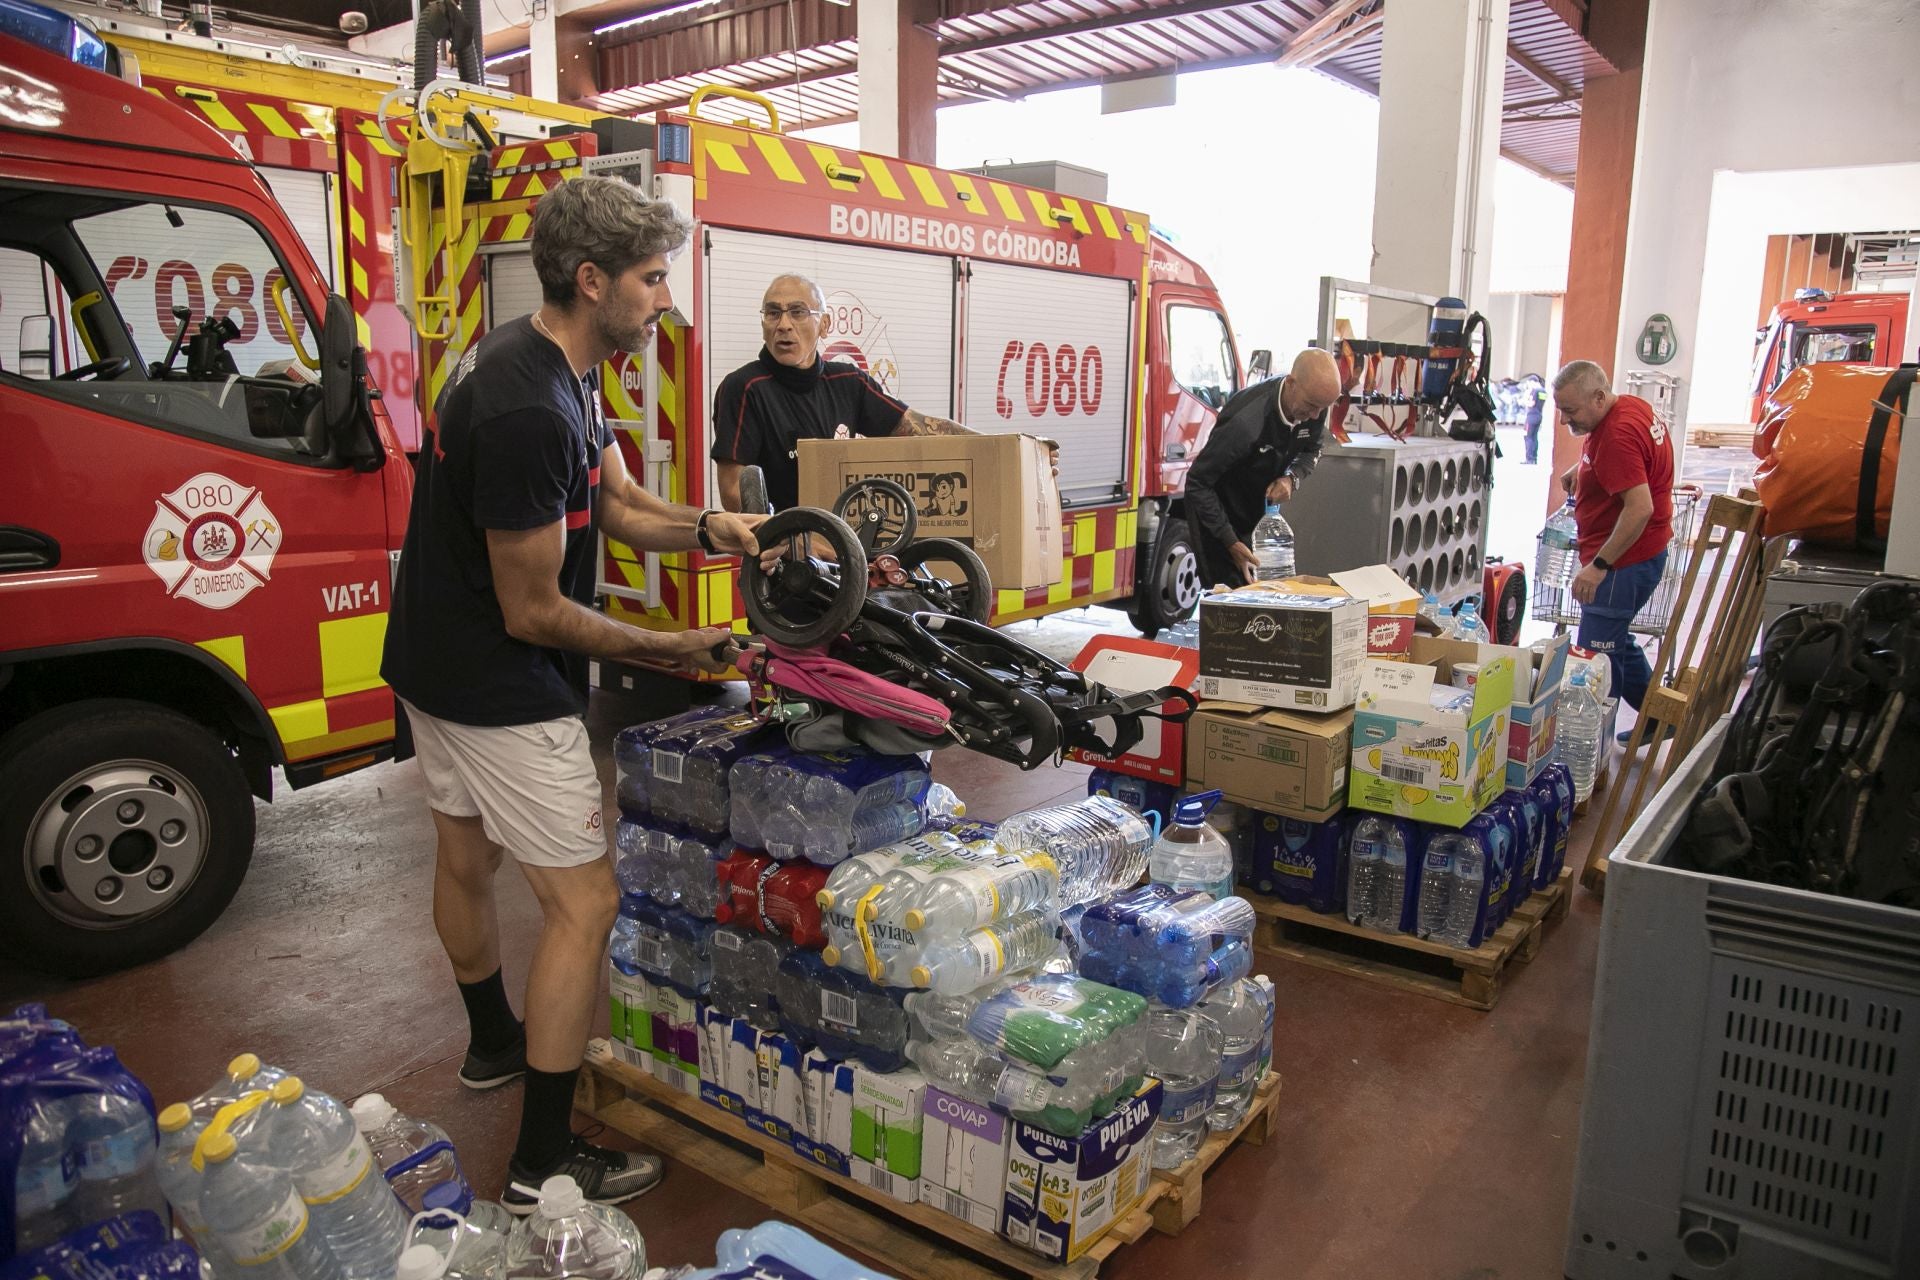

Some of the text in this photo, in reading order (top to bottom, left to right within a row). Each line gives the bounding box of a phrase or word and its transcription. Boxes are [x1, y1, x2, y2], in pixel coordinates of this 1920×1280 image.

[830, 204, 1081, 268] BOMBEROS CÓRDOBA
[1025, 341, 1103, 418] 080
[185, 484, 233, 509] 080
[194, 572, 246, 595] BOMBEROS
[322, 580, 380, 612] VAT-1
[1590, 641, 1615, 649] SEUR
[860, 1085, 904, 1109] SEMIDESNATADA
[937, 1098, 988, 1129] COVAP
[1101, 1100, 1150, 1151] PULEVA
[1023, 1125, 1068, 1151] PULEVA
